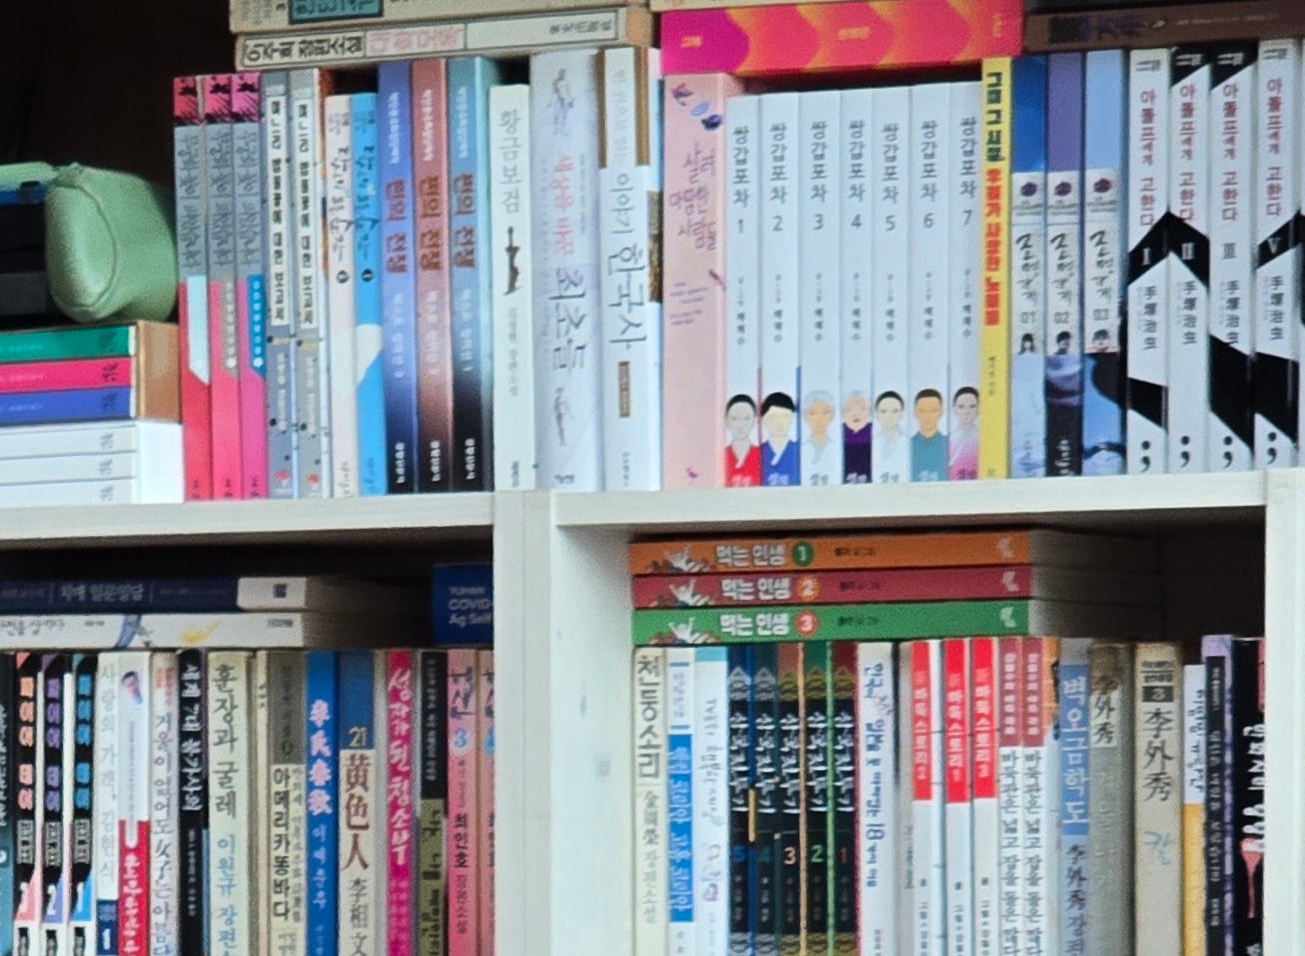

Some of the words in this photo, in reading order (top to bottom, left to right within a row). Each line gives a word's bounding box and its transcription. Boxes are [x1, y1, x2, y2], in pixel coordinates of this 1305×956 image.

[1140, 88, 1156, 167] 아돌프에게
[1179, 83, 1196, 160] 아돌프에게
[1222, 83, 1239, 160] 아돌프에게
[1266, 77, 1283, 154] 아돌프에게
[499, 109, 523, 214] 황금보검
[732, 126, 750, 209] 쌍갑포차
[770, 122, 788, 205] 쌍갑포차
[810, 120, 828, 203] 쌍갑포차
[848, 119, 866, 202] 쌍갑포차
[882, 123, 900, 206] 쌍갑포차
[921, 120, 939, 203] 쌍갑포차
[960, 116, 978, 199] 쌍갑포차
[609, 172, 635, 235] 이야기
[962, 209, 974, 226] 7
[1139, 177, 1156, 226] 고한다
[1178, 171, 1196, 222] 고한다
[1221, 171, 1239, 222] 고한다
[1265, 166, 1283, 217] 고한다
[737, 218, 745, 234] 1
[772, 215, 784, 232] 2
[812, 214, 825, 230] 3
[851, 213, 863, 230] 4
[885, 215, 896, 231] 5
[923, 212, 934, 229] 6
[386, 232, 407, 273] 전쟁
[419, 229, 442, 271] 전쟁
[453, 227, 477, 268] 전쟁
[607, 243, 648, 350] 한국사
[716, 546, 749, 567] 먹는
[752, 545, 786, 566] 인생
[799, 547, 808, 562] 1
[721, 578, 754, 601] 먹는
[757, 577, 791, 600] 인생
[802, 583, 814, 597] 2
[720, 613, 753, 637] 먹는
[755, 612, 790, 637] 인생
[802, 614, 814, 631] 3
[182, 664, 202, 697] 세계
[388, 667, 412, 735] 성자가
[212, 664, 238, 752] 훈장과
[638, 656, 662, 780] 천둥소리
[348, 726, 368, 747] 21
[389, 740, 411, 772] 된
[454, 727, 468, 748] 3
[1062, 675, 1090, 824] 벽오금학도
[1143, 708, 1174, 802] 李外秀
[212, 761, 238, 819] 굴레
[1000, 751, 1020, 815] 바둑판은
[1023, 751, 1043, 815] 바둑판은
[272, 767, 291, 922] 아메리카똥바다
[388, 775, 411, 867] 청소부
[454, 814, 469, 869] 최인호
[1001, 818, 1020, 849] 넓고
[1024, 818, 1043, 849] 넓고
[217, 834, 236, 897] 이원규
[784, 847, 797, 864] 3
[811, 844, 824, 862] 2
[1143, 831, 1172, 865] 칼
